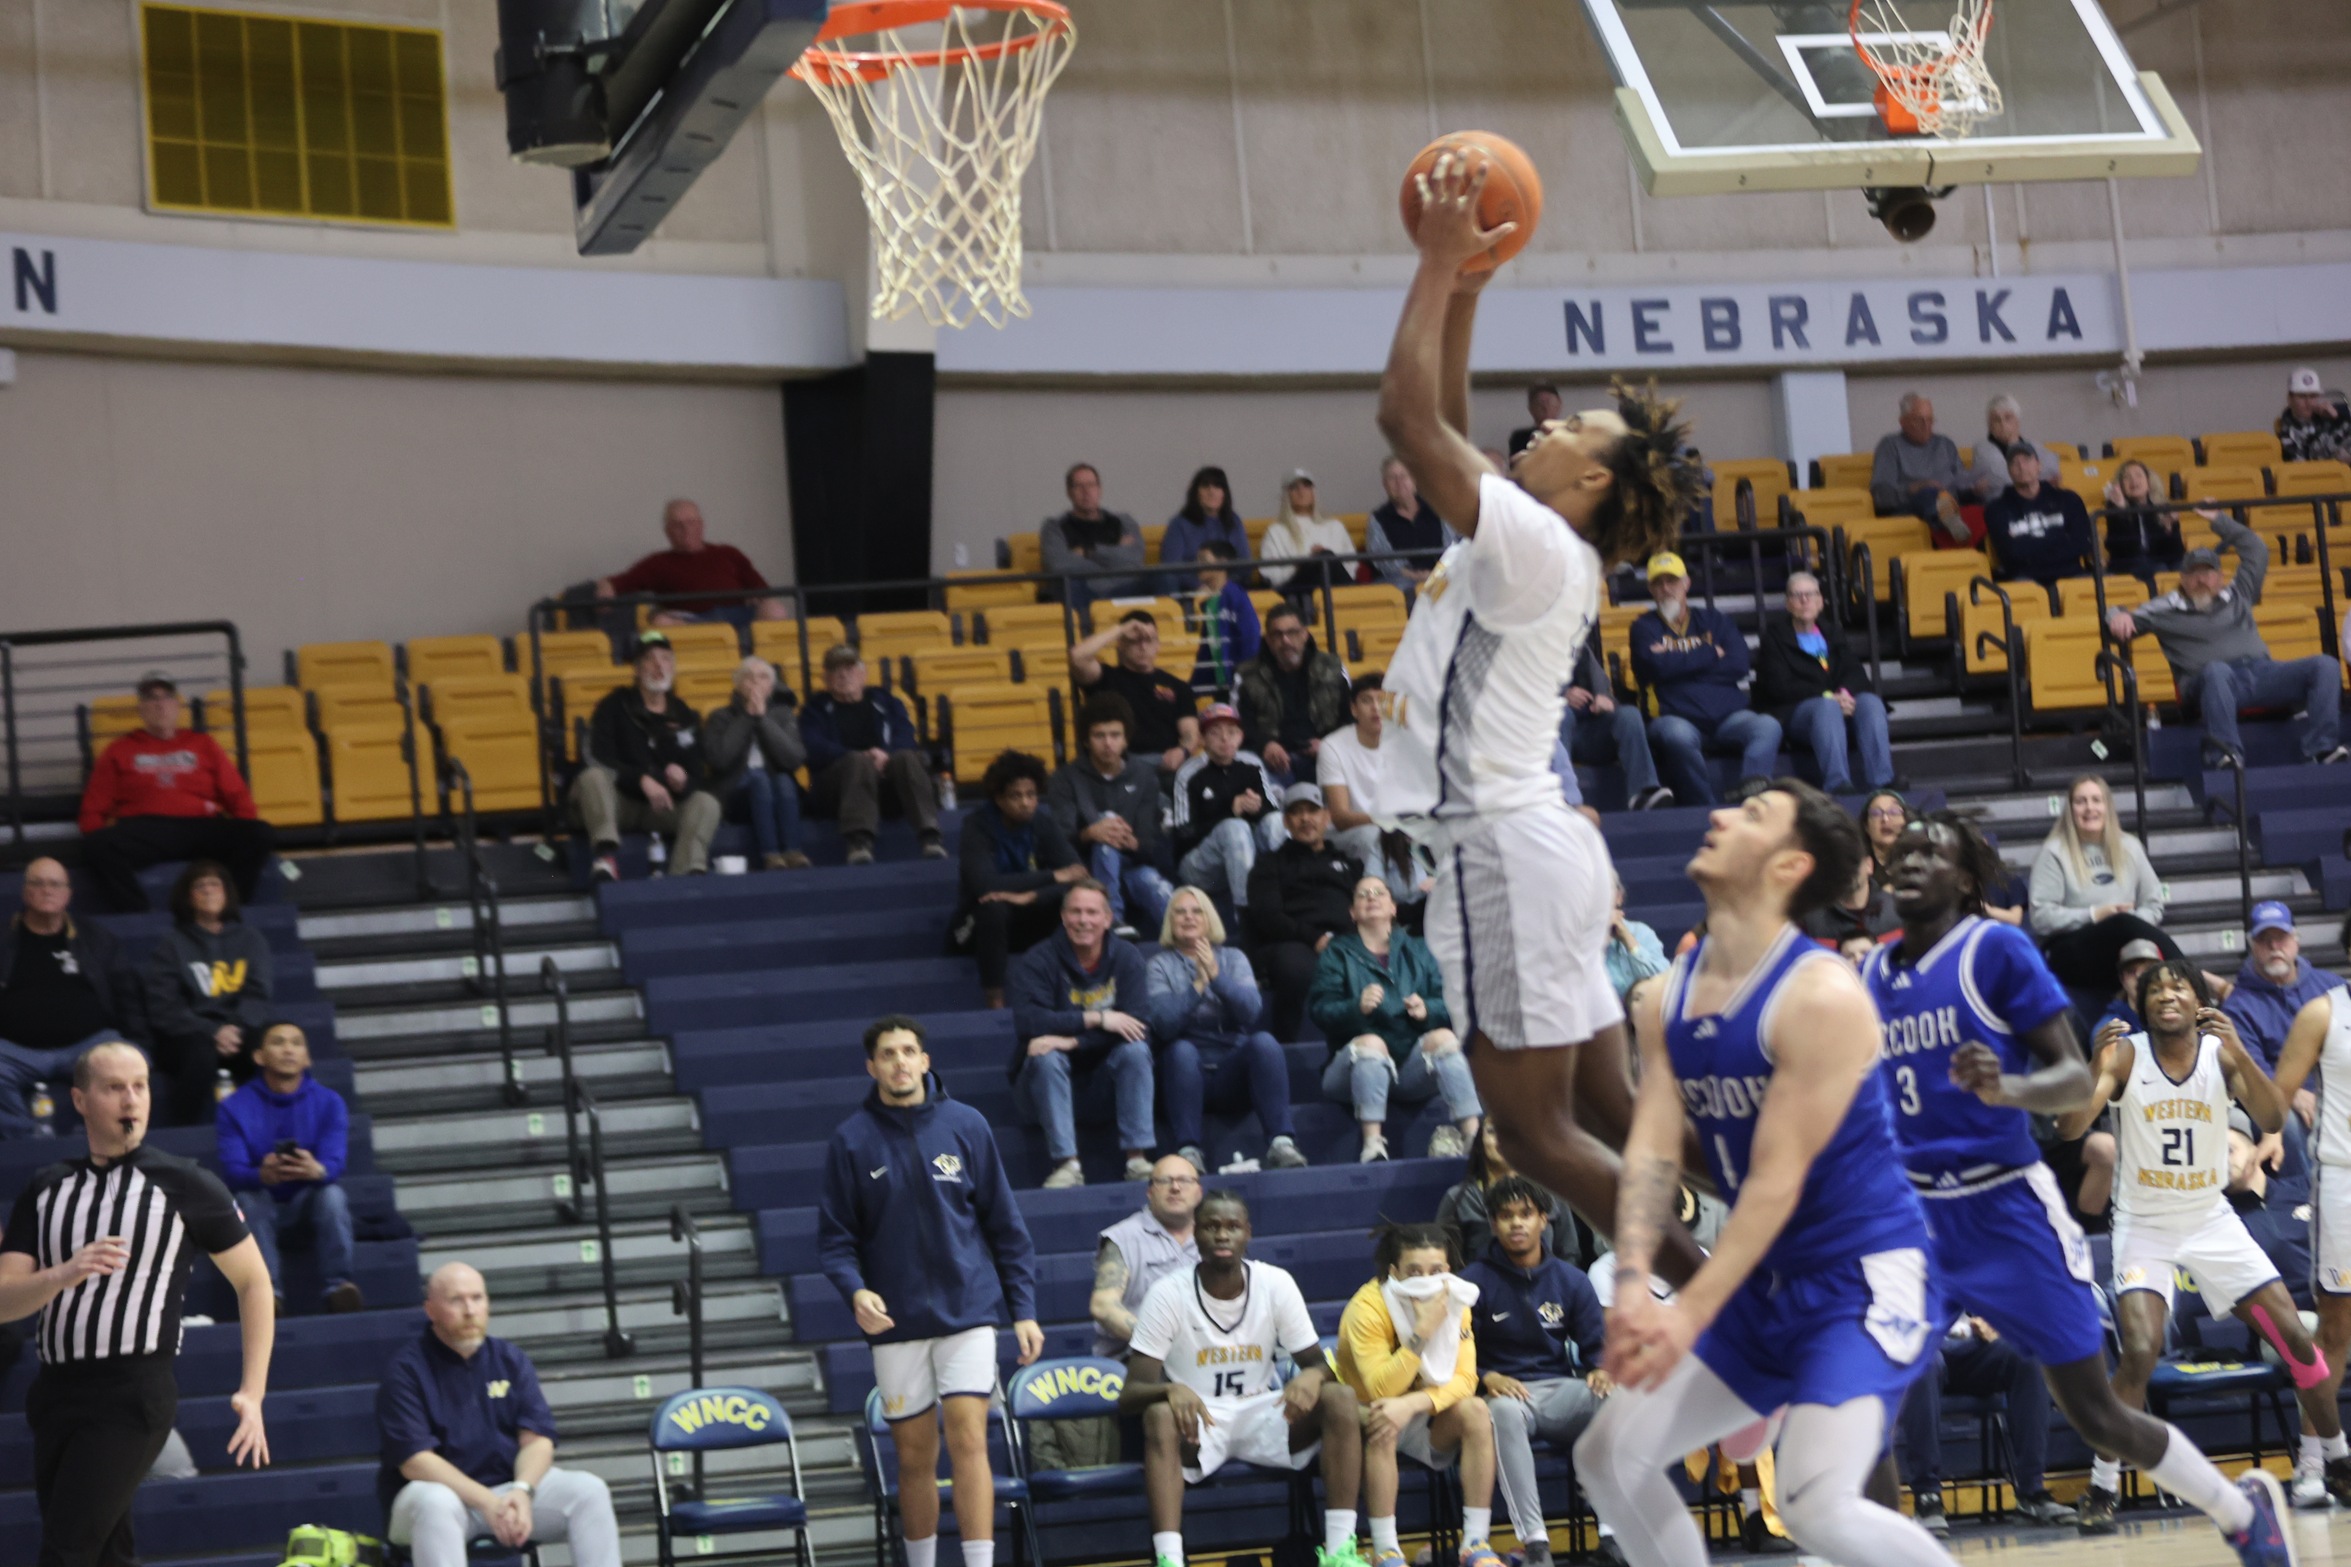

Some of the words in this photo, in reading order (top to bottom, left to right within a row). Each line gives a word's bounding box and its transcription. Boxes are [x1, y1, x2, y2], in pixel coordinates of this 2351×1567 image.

[1563, 287, 2083, 355] NEBRASKA
[1896, 1065, 1921, 1117] 3
[2143, 1099, 2213, 1124] WESTERN
[2162, 1128, 2194, 1166] 21
[2137, 1167, 2218, 1191] NEBRASKA
[1196, 1345, 1263, 1368] WESTERN
[1026, 1366, 1123, 1405] WNCC
[1214, 1370, 1245, 1397] 15
[669, 1395, 771, 1434] WNCC
